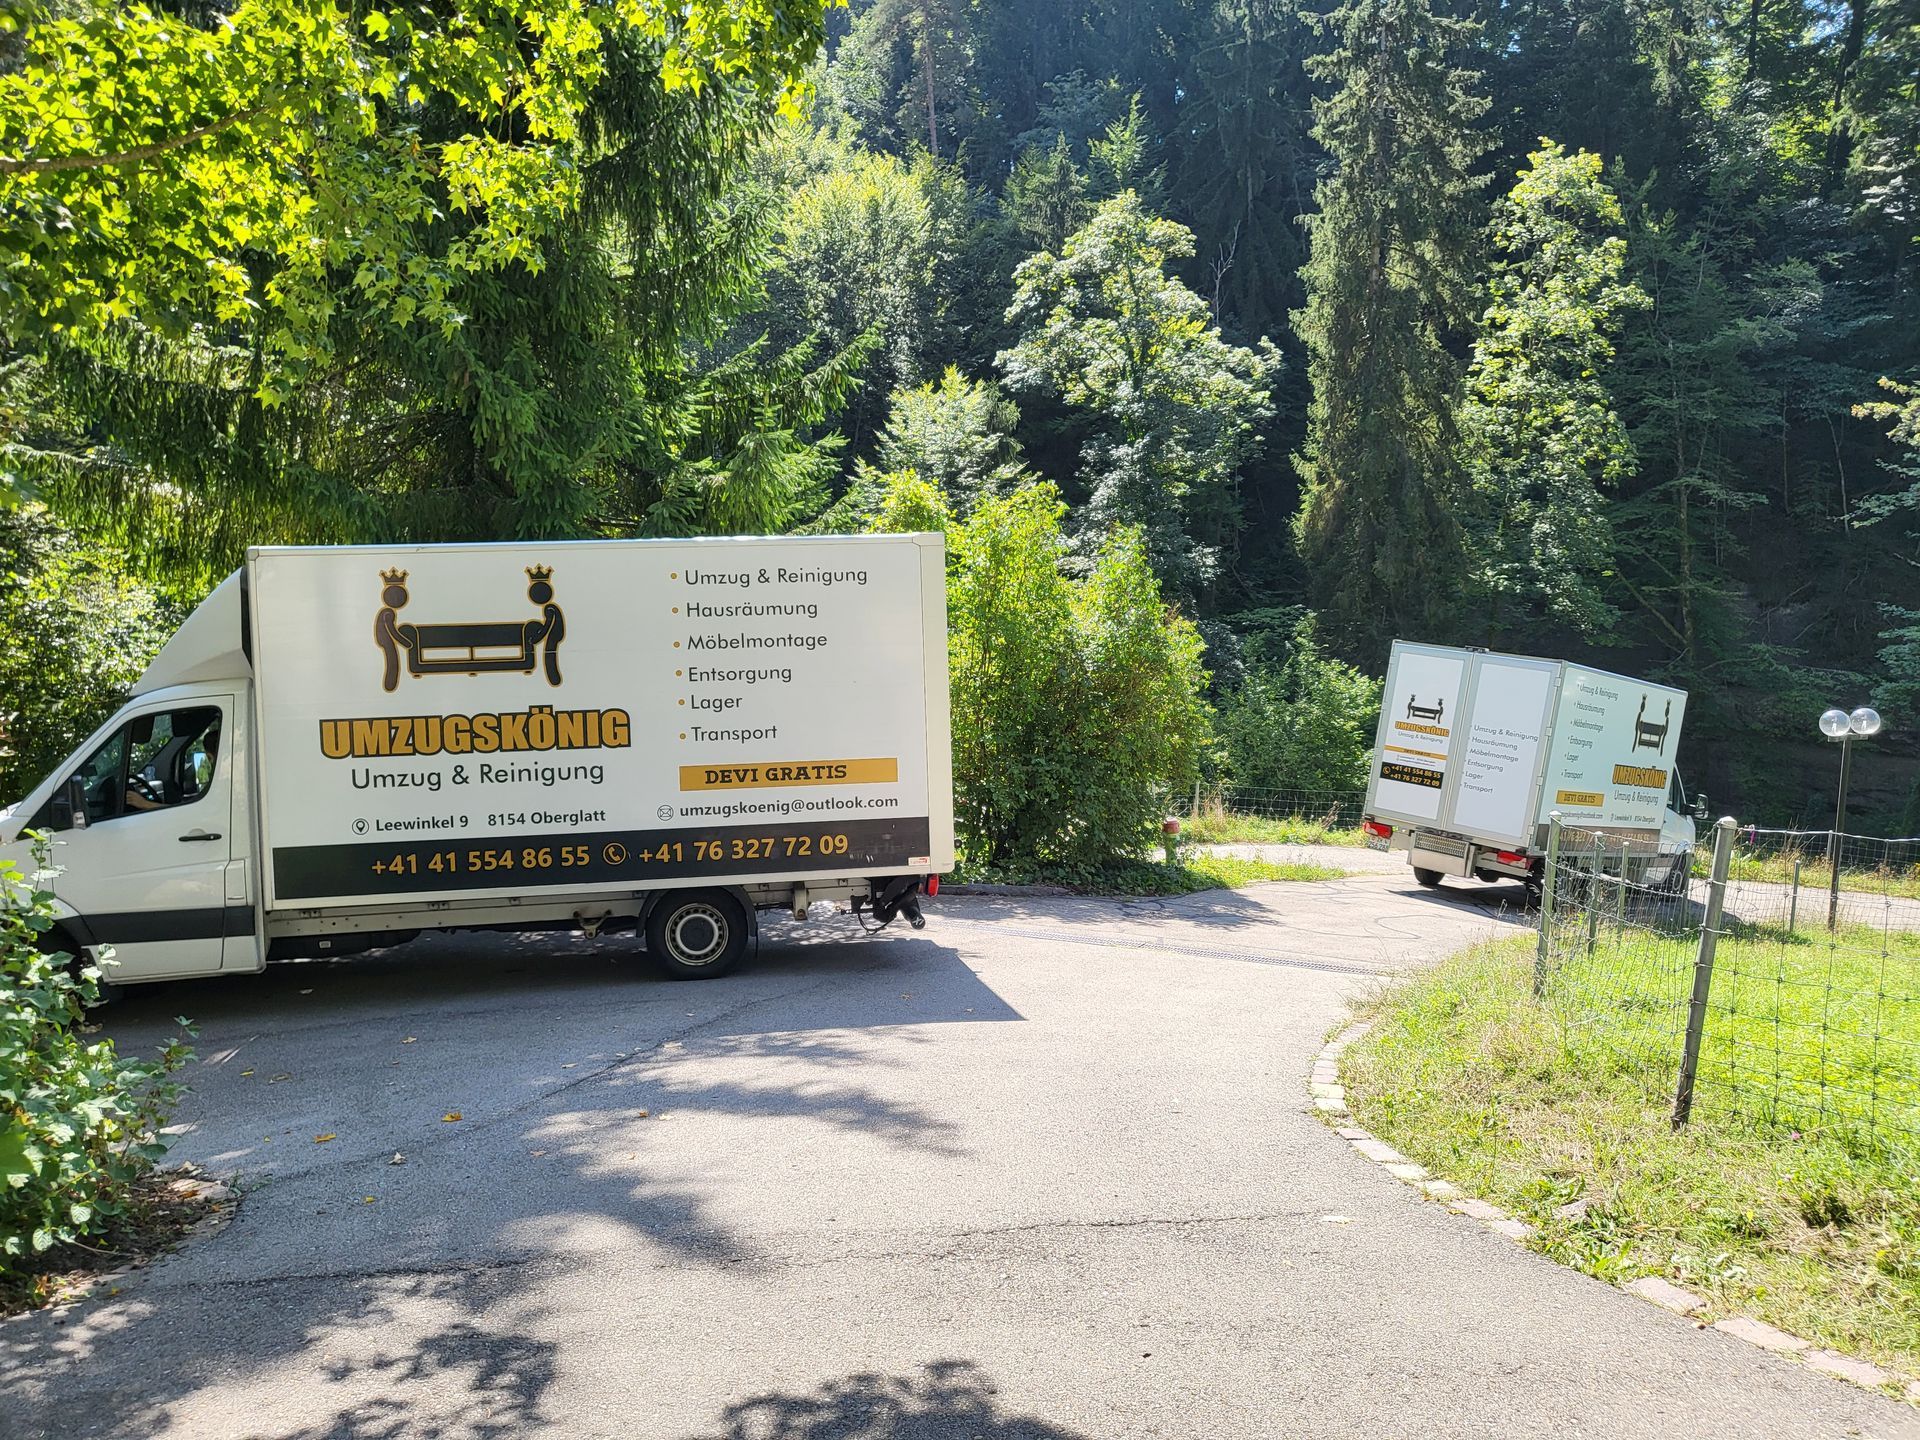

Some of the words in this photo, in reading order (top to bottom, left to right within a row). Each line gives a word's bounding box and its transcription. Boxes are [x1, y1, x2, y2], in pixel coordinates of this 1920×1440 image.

[685, 569, 751, 588] Umzug
[757, 568, 771, 584] &
[777, 567, 868, 586] Reinigung
[686, 602, 818, 618] Hausräumung
[687, 633, 828, 650] Möbelmontage
[688, 665, 792, 684] Entsorgung
[690, 695, 743, 713] Lager
[319, 704, 631, 759] UMZUGSKÖNIG
[691, 725, 778, 744] Transport
[1473, 724, 1497, 735] Umzug
[1505, 729, 1539, 742] Reinigung
[1471, 736, 1518, 750] Hausräumung
[1469, 747, 1519, 762] Möbelmontage
[705, 768, 759, 785] DEVI
[765, 764, 848, 782] GRATIS
[1467, 758, 1504, 773] Entsorgung
[351, 768, 441, 791] Umzug
[451, 764, 470, 785] &
[480, 762, 605, 787] Reinigung
[1465, 770, 1483, 781] Lager
[1463, 781, 1493, 794] Transport
[680, 796, 899, 819] umzugskoenig@outlook.com
[375, 815, 455, 832] Leewinkel
[459, 815, 469, 829] 9
[487, 812, 526, 827] 8154
[531, 809, 606, 827] Oberglatt
[639, 843, 683, 863] +41
[694, 840, 723, 861] 76
[731, 838, 775, 858] 327
[783, 836, 812, 856] 72
[819, 834, 849, 855] 09
[371, 854, 418, 875] +41
[427, 852, 457, 873] 41
[468, 849, 514, 871] 554
[521, 847, 553, 868] 86
[560, 845, 590, 866] 55
